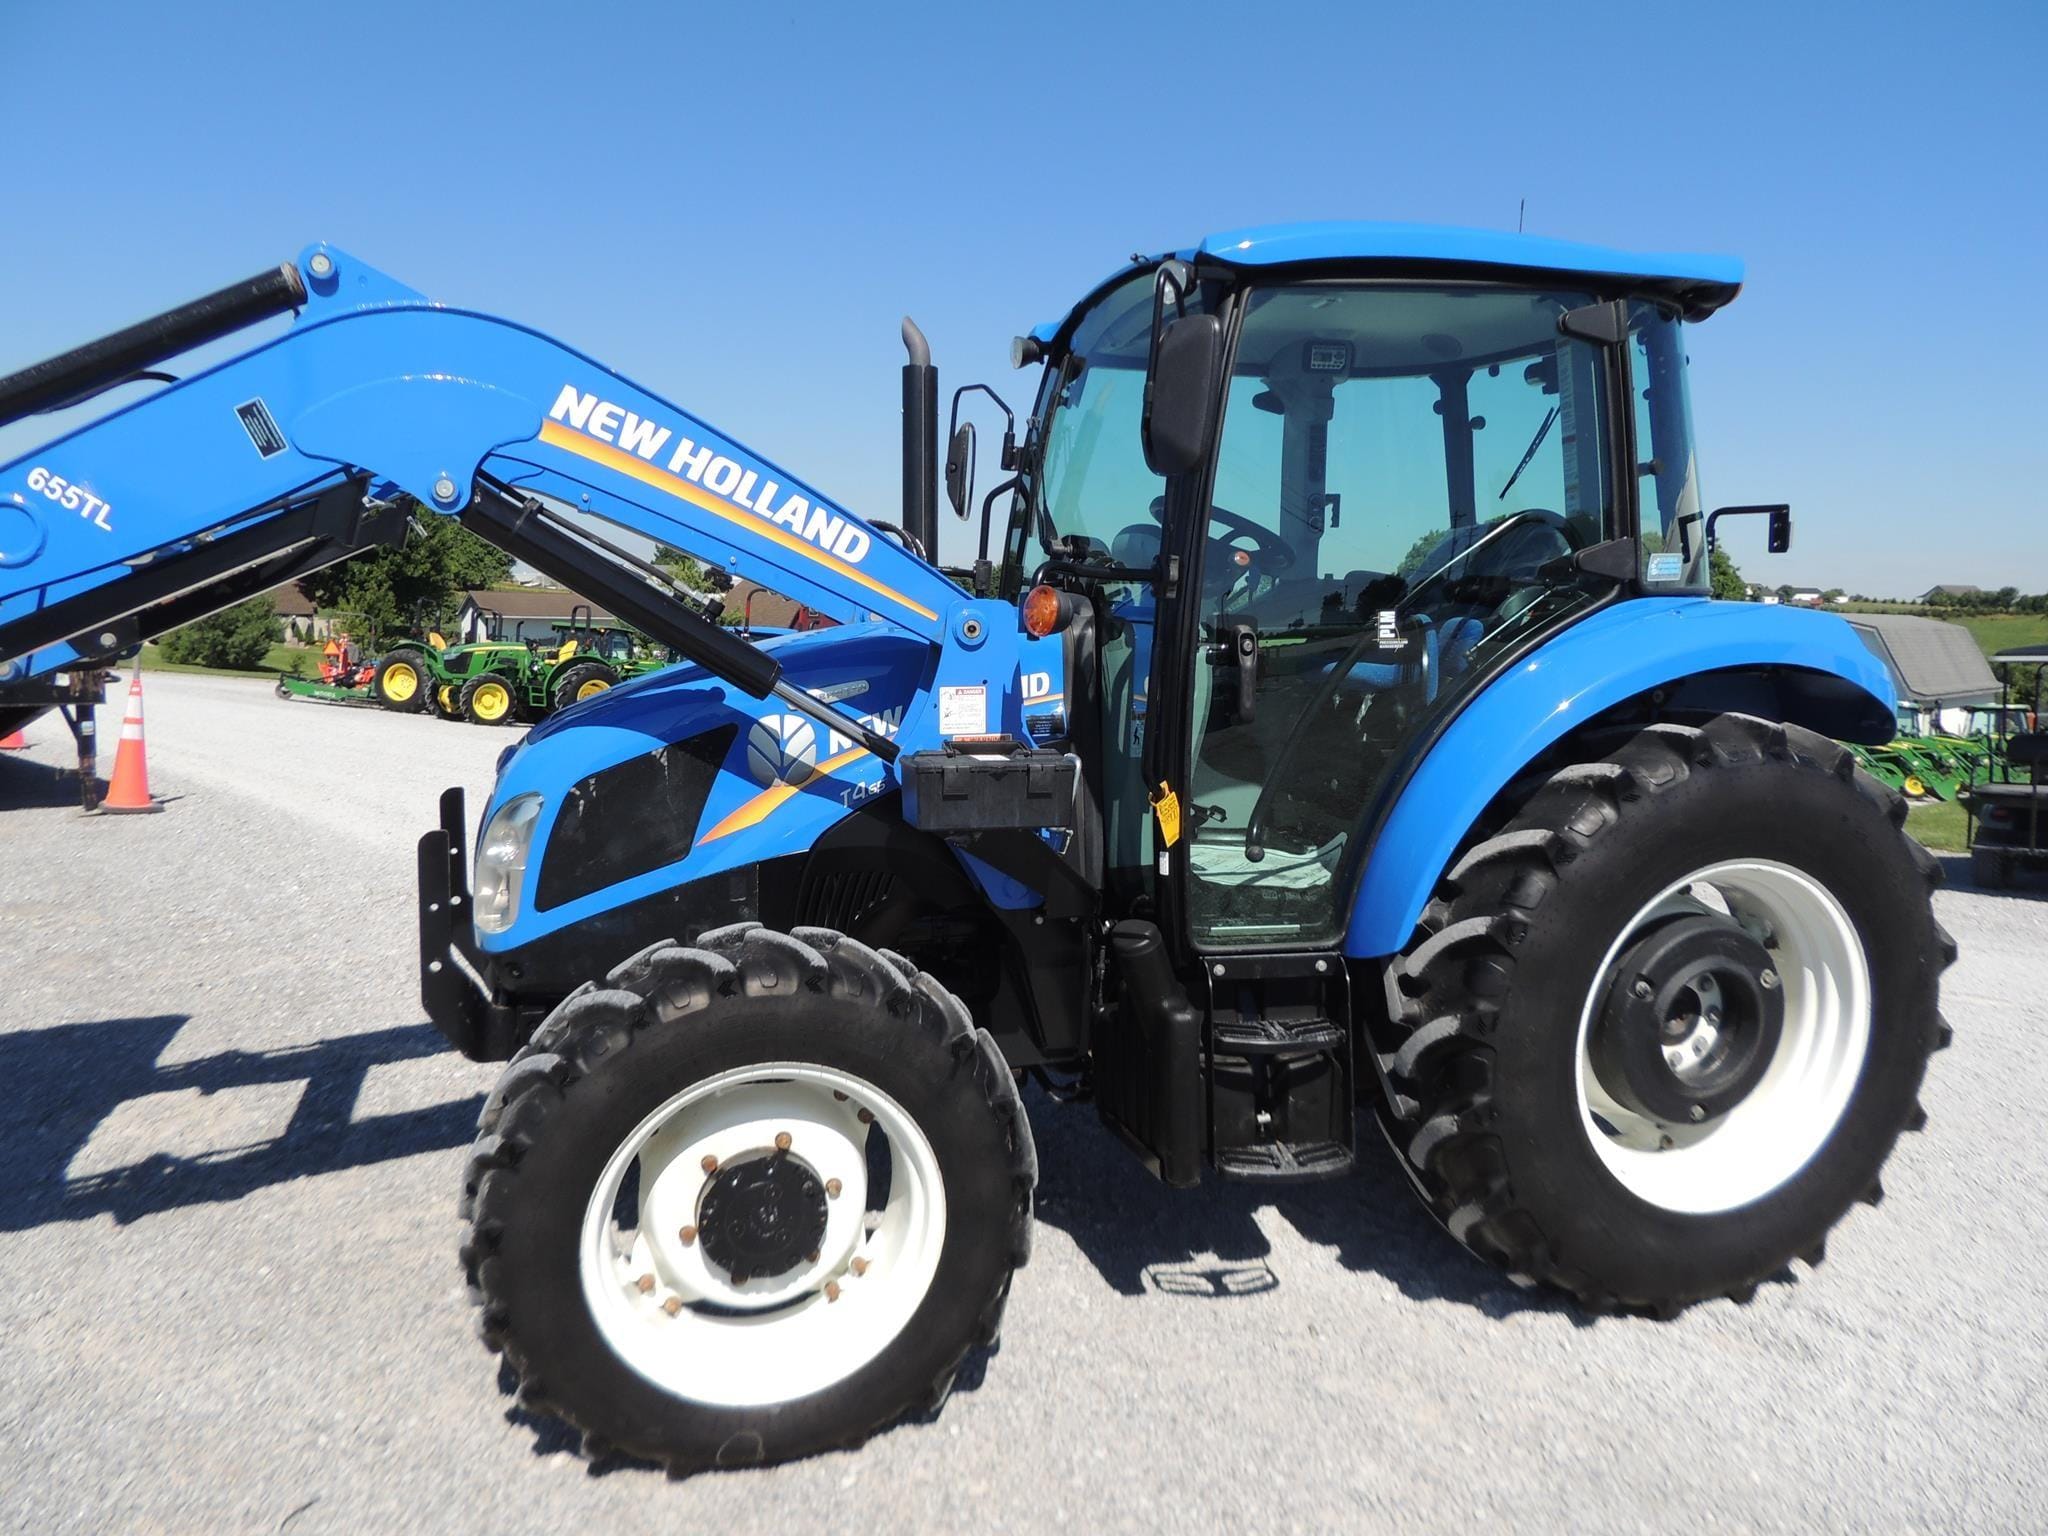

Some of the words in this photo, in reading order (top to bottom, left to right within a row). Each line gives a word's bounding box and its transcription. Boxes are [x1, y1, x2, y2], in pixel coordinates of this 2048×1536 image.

[27, 467, 112, 532] 655TL
[549, 384, 671, 460] NEW
[668, 436, 871, 564] HOLLAND
[1379, 611, 1396, 638] PLM
